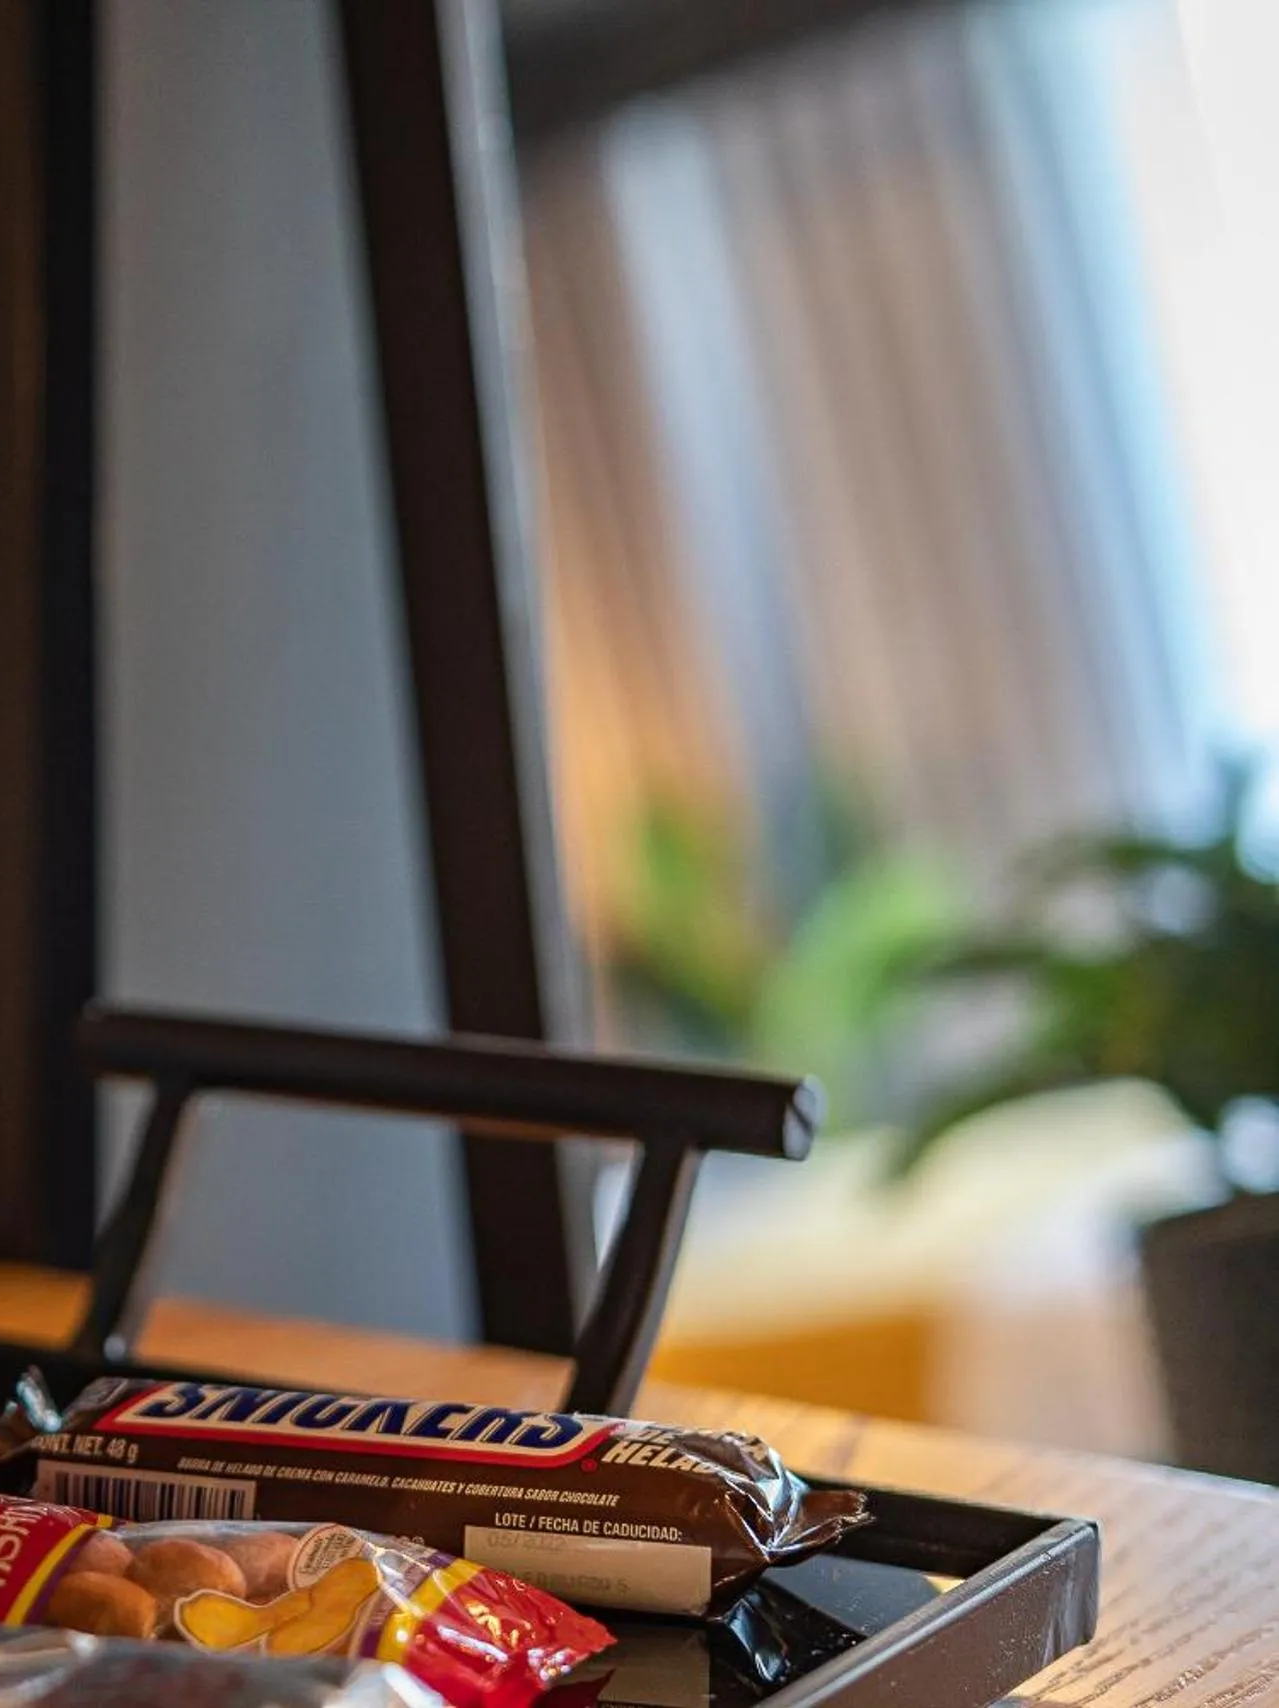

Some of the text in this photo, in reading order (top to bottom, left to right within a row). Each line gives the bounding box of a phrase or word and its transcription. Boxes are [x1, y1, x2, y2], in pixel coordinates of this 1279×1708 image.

[312, 1469, 336, 1482] CON
[391, 1476, 457, 1494] CACAHUATES
[456, 1481, 465, 1495] Y
[465, 1483, 523, 1499] COBERTURA
[524, 1488, 560, 1502] SABOR
[559, 1490, 620, 1508] CHOCOLATE
[495, 1512, 683, 1542] LOTE / FECHA DE CADUCIDAD:
